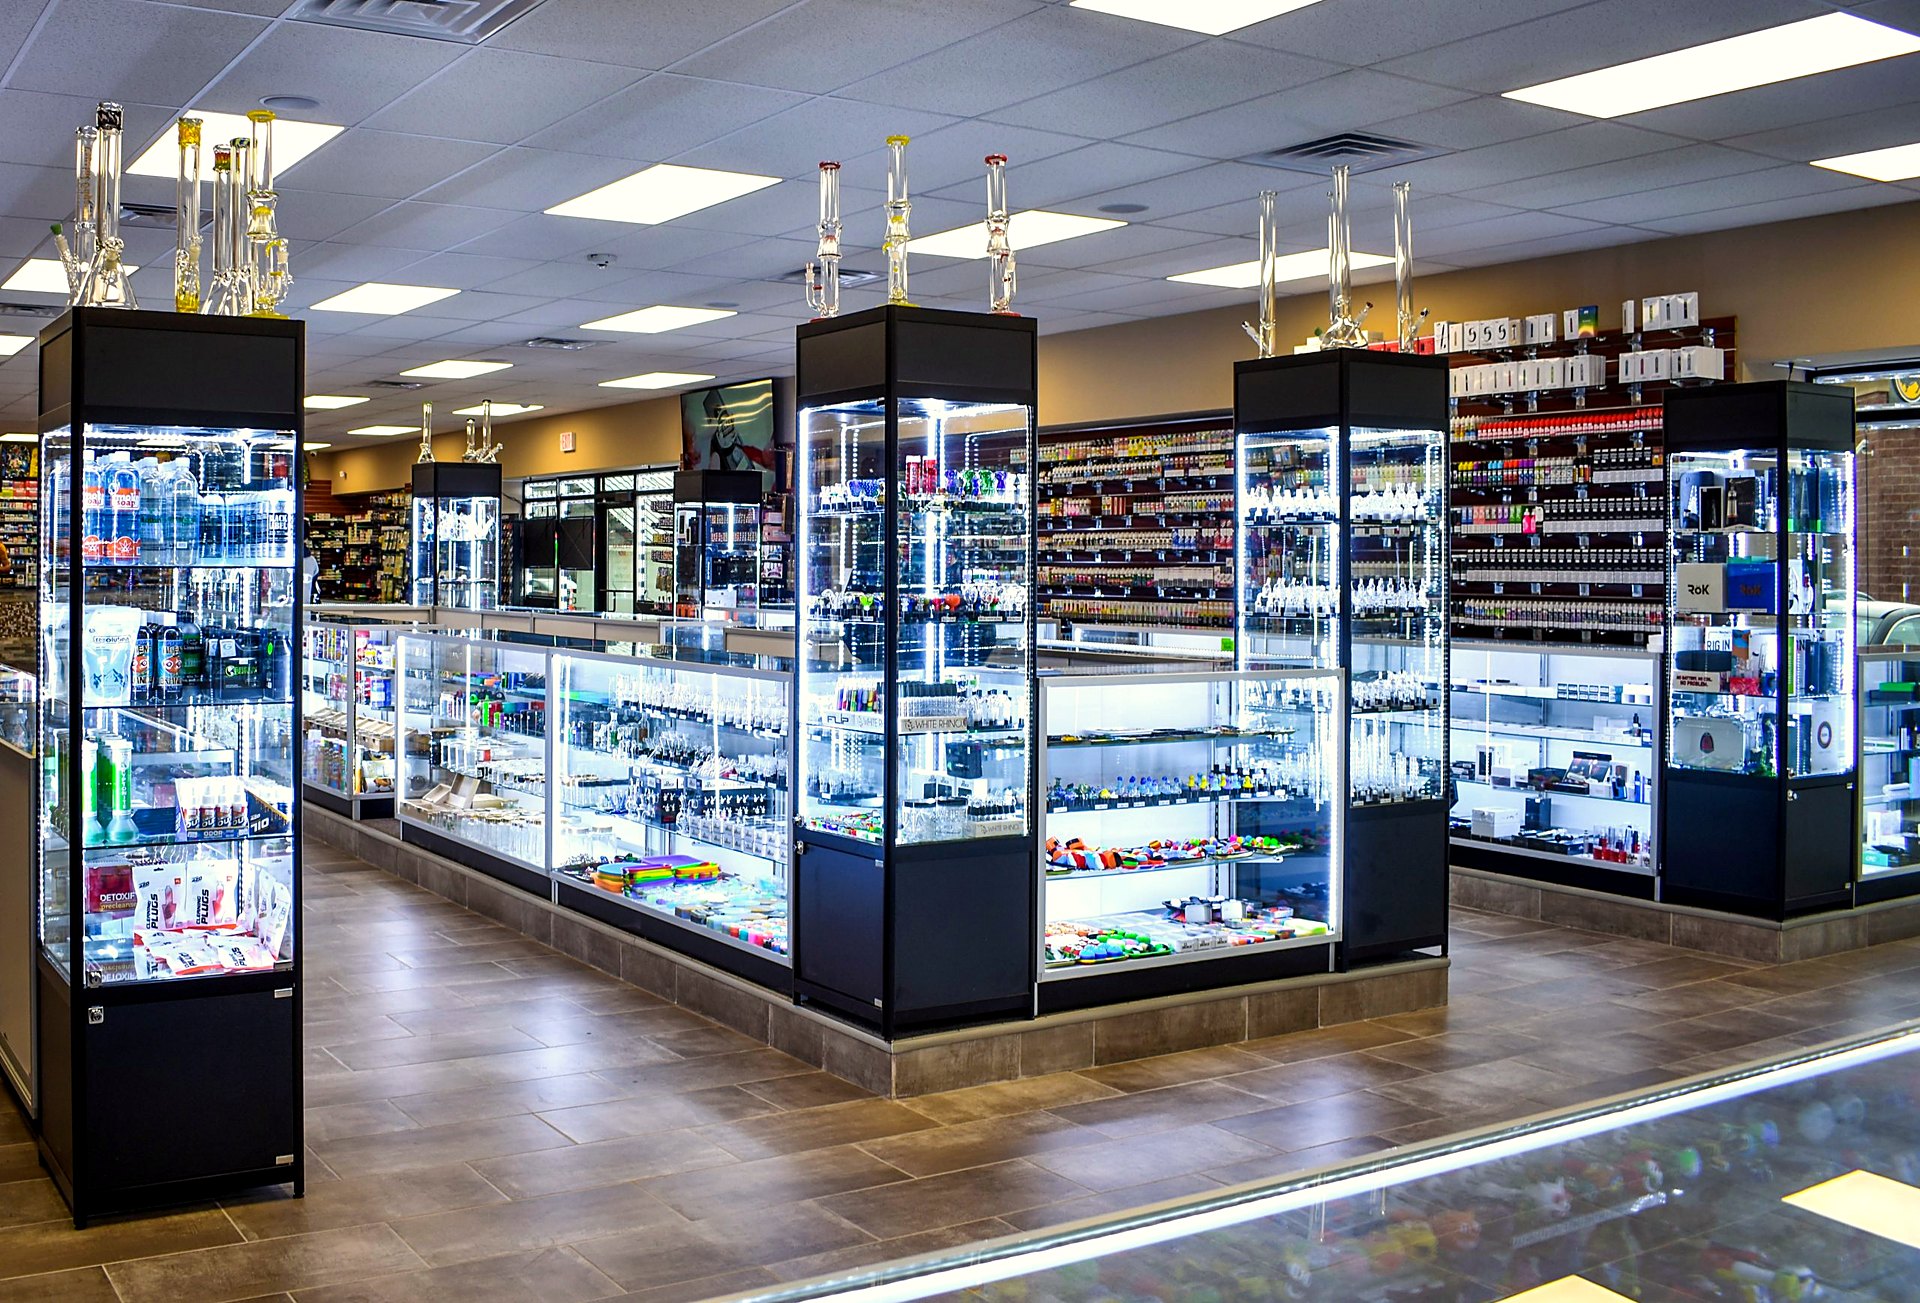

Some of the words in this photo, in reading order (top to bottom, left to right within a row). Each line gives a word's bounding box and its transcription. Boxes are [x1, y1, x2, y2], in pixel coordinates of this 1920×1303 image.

[1706, 640, 1720, 651] RIG
[1722, 639, 1731, 650] IN
[914, 719, 937, 729] WHITE
[939, 718, 962, 728] RHINO
[250, 818, 270, 833] 710
[99, 892, 136, 902] DETOXIF
[151, 893, 159, 929] PLUGS
[201, 889, 209, 924] PLUGS
